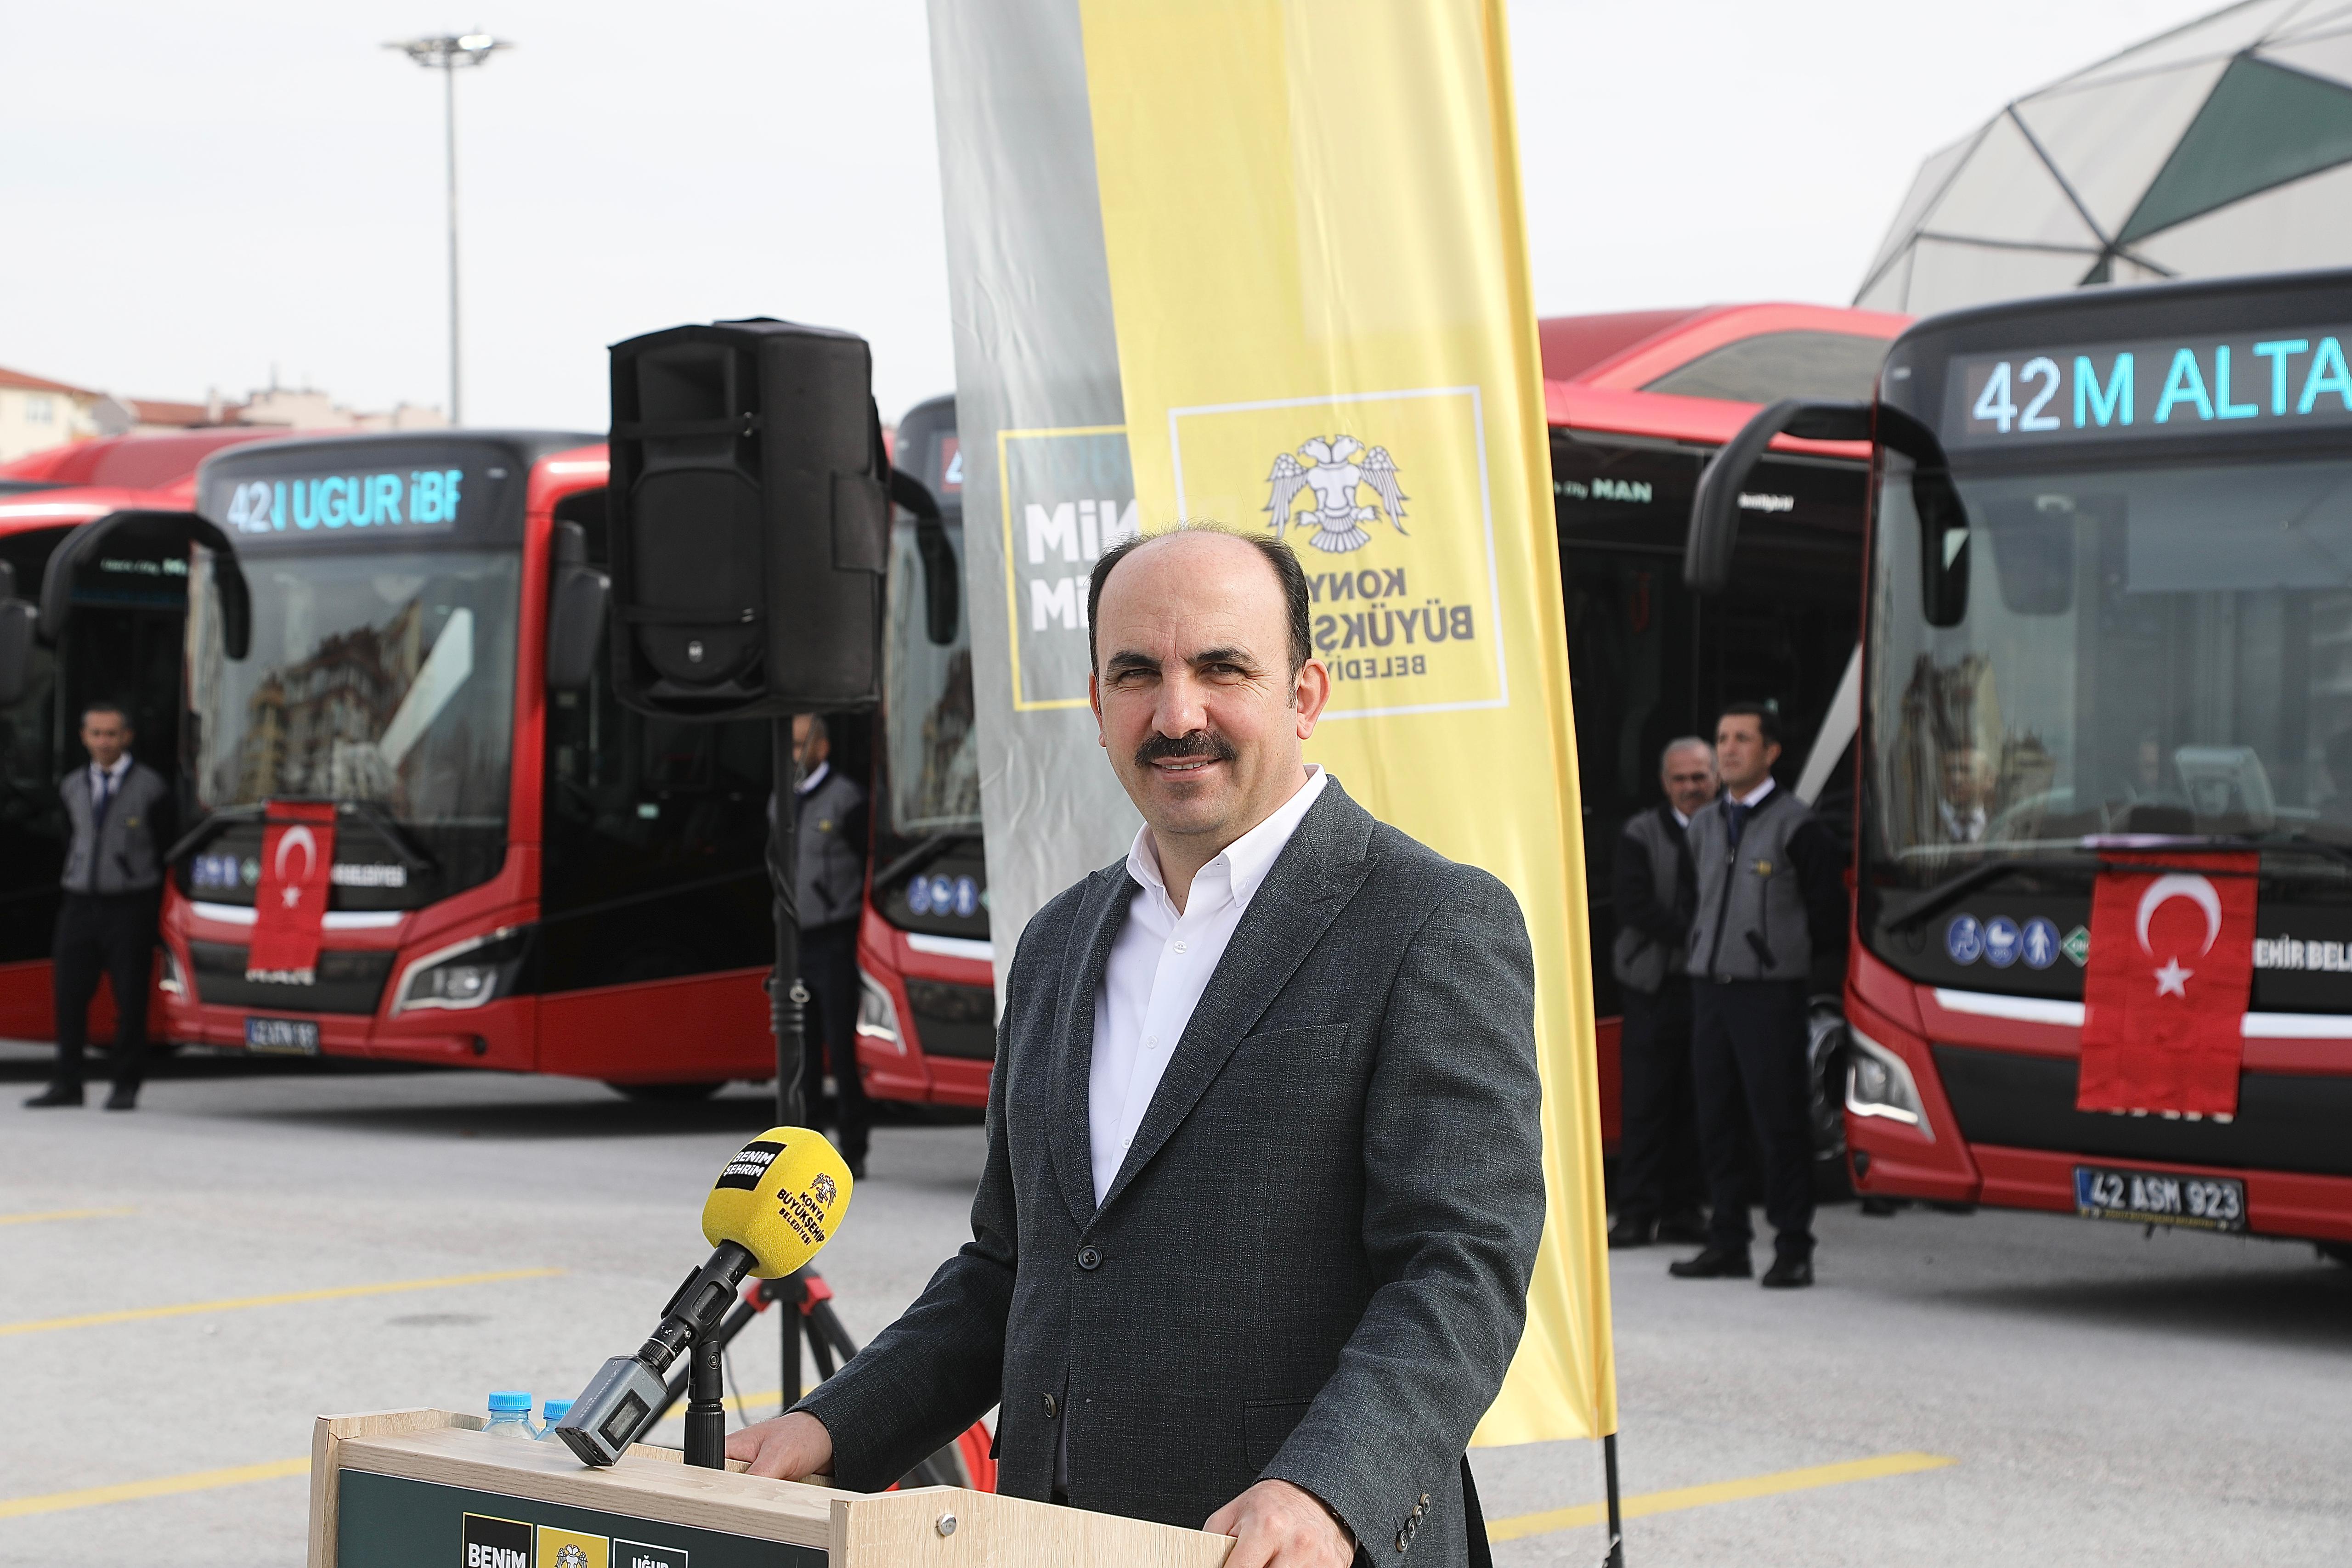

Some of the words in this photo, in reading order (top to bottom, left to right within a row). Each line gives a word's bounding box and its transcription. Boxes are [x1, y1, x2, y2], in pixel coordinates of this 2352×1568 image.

[1973, 356, 2061, 433] 42
[2073, 352, 2134, 428] M
[2153, 337, 2352, 423] ALTA
[227, 480, 273, 534] 42
[292, 474, 403, 530] UGUR
[1591, 477, 1653, 504] MAN
[2252, 932, 2305, 970] EHİR
[2305, 939, 2352, 973] BEL
[723, 1164, 765, 1177] ŞEHRiM
[732, 1151, 775, 1165] BENiM
[799, 1191, 825, 1224] KONYA
[2091, 1172, 2127, 1209] 42
[2185, 1179, 2241, 1220] 923
[469, 1543, 526, 1568] BENiM
